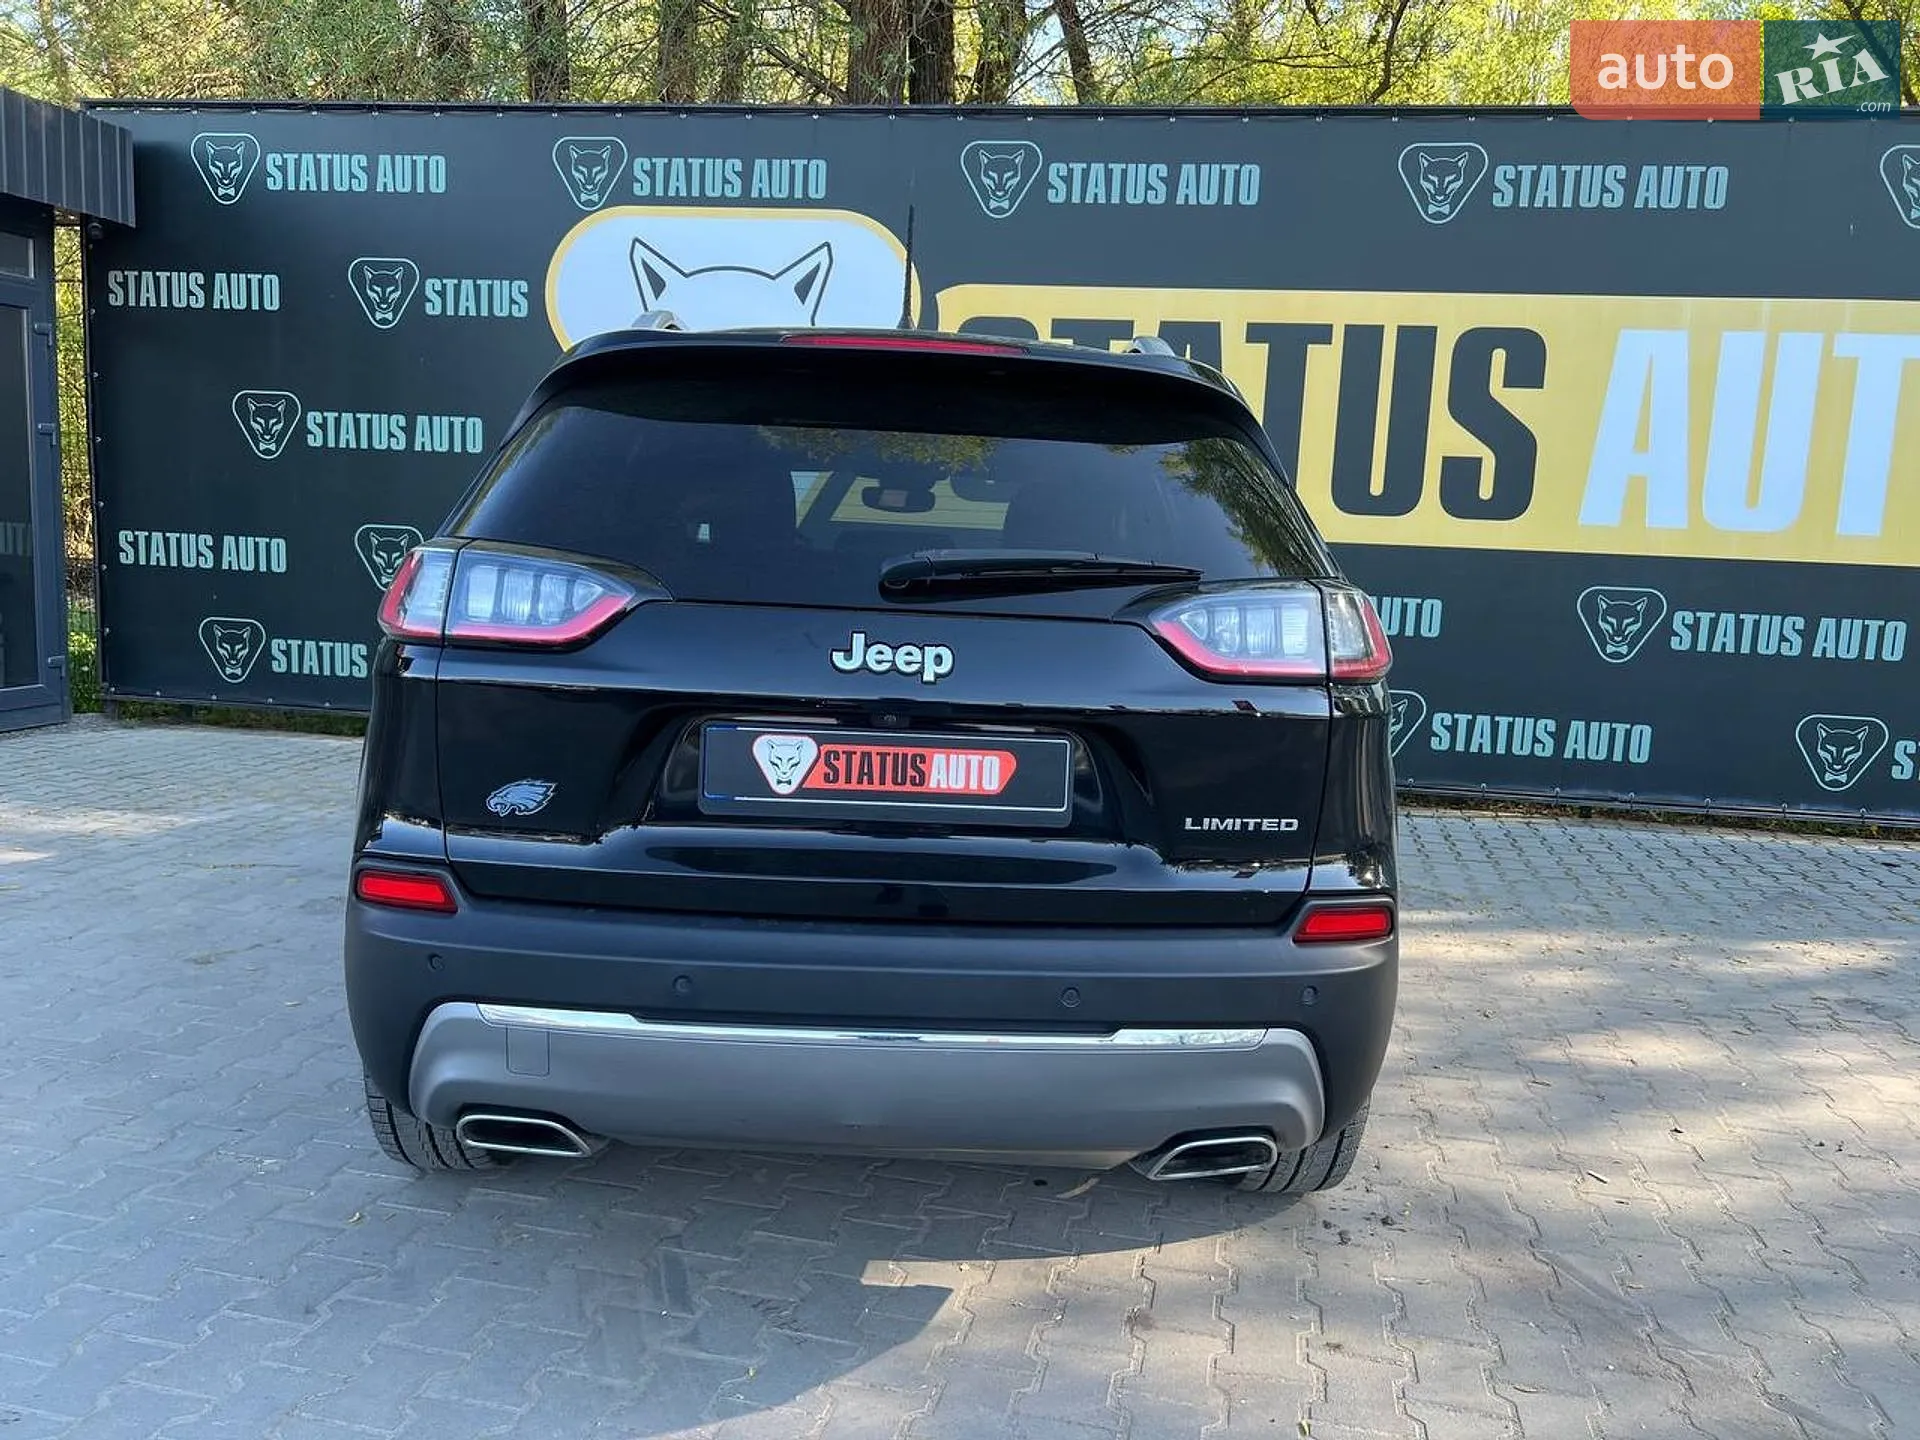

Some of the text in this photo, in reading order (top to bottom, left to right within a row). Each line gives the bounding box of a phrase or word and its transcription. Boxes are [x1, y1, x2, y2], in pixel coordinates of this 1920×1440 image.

[265, 153, 446, 194] STATUS AUTO
[633, 157, 827, 200] STATUS AUTO
[1047, 162, 1260, 206] STATUS AUTO
[1492, 164, 1729, 210] STATUS AUTO
[108, 270, 280, 311] STATUS AUTO
[424, 278, 529, 318] STATUS
[306, 411, 483, 454] STATUS AUTO
[118, 530, 287, 573] STATUS AUTO
[829, 631, 954, 684] Jeep
[1670, 610, 1907, 662] STATUS AUTO
[271, 638, 368, 678] STATUS
[1430, 712, 1653, 764] STATUS AUTO
[1184, 817, 1299, 832] LIMITED
